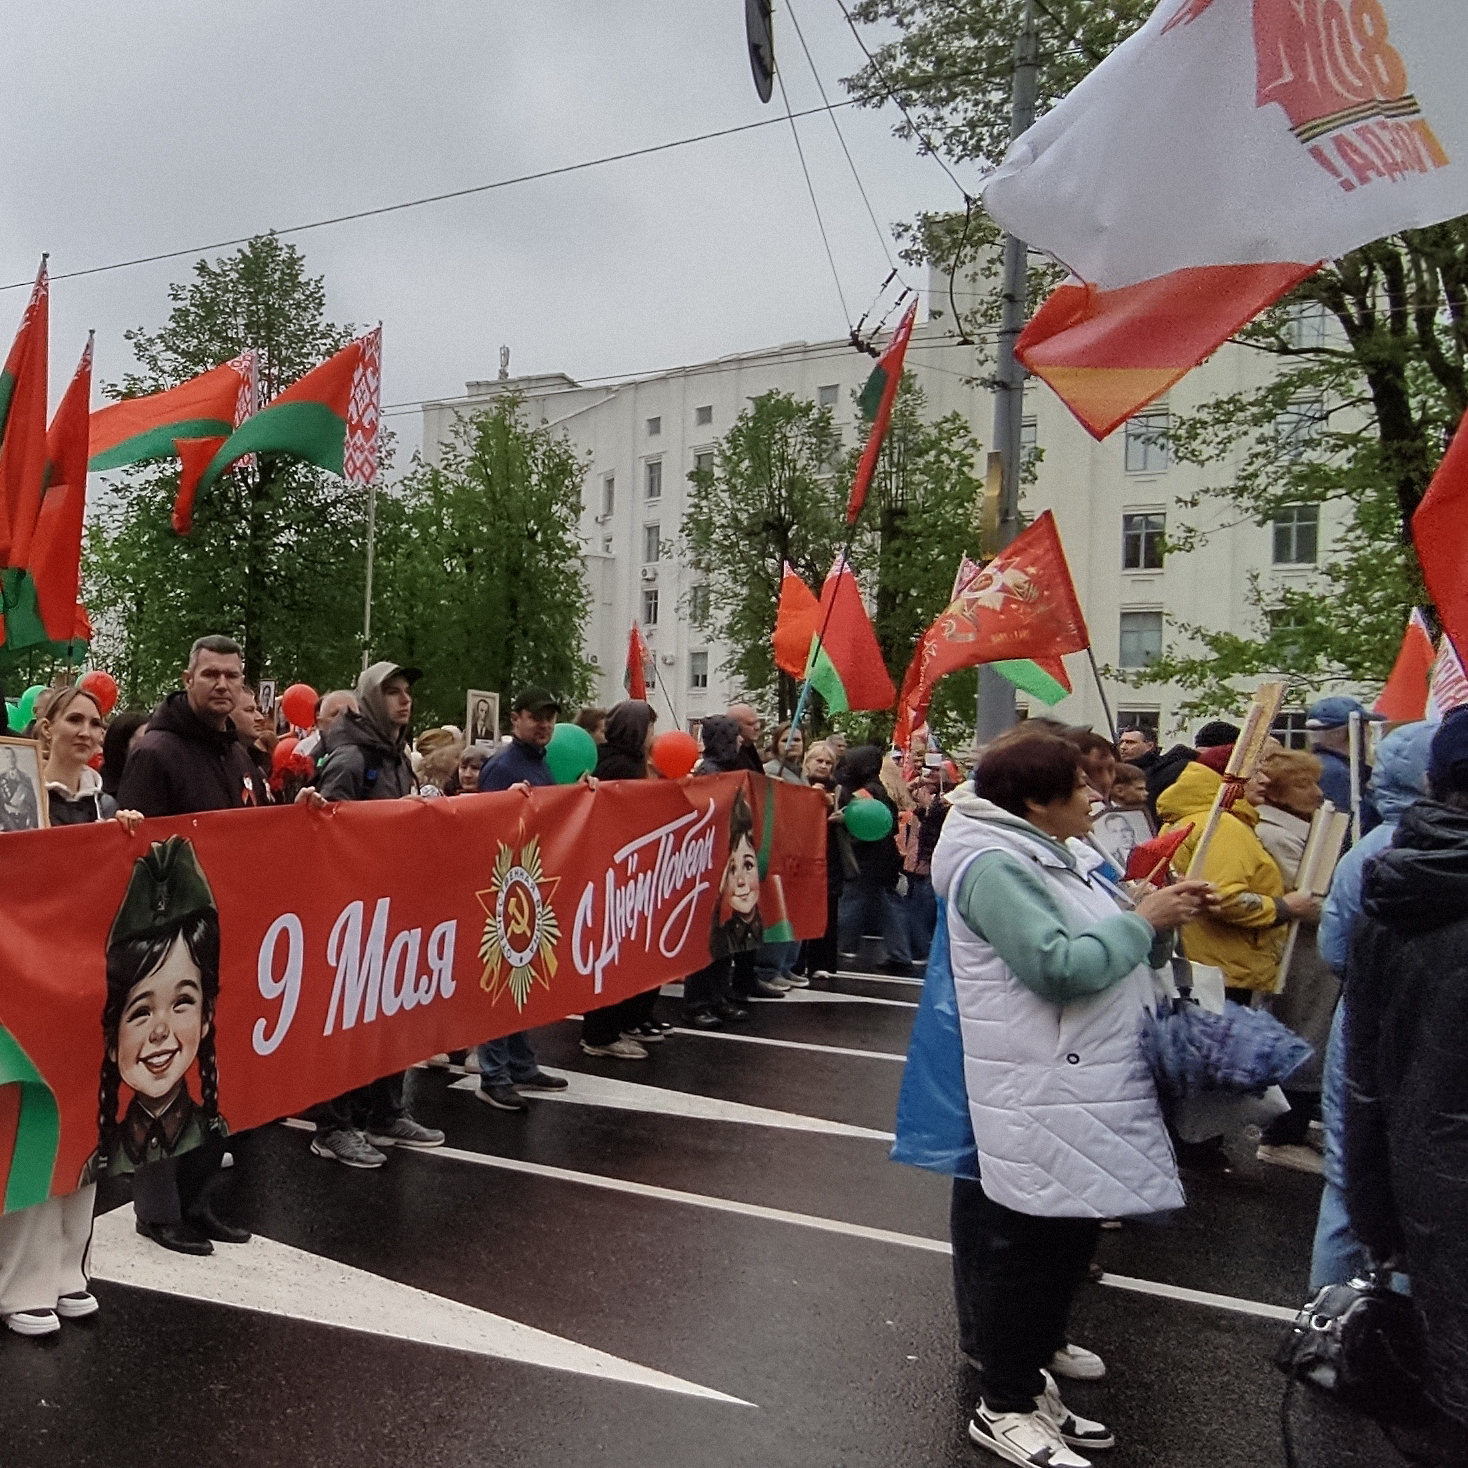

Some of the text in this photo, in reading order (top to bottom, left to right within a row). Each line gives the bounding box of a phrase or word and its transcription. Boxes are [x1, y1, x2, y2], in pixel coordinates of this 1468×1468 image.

[252, 896, 458, 1056] 9 Мая
[572, 881, 594, 975] С
